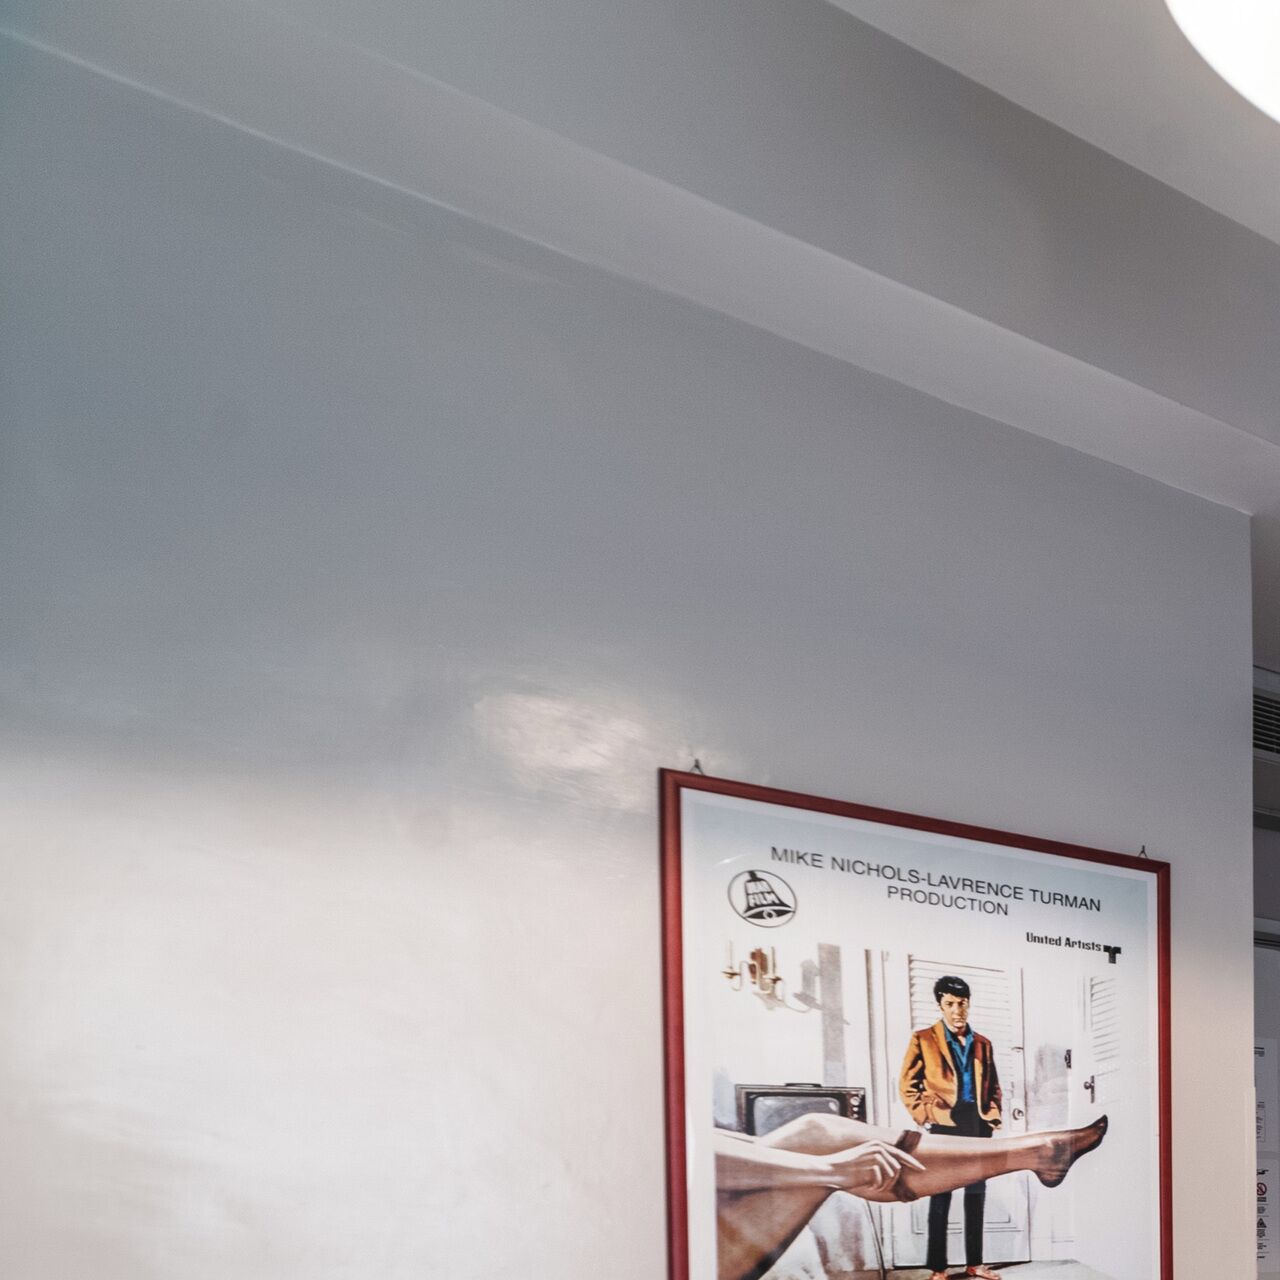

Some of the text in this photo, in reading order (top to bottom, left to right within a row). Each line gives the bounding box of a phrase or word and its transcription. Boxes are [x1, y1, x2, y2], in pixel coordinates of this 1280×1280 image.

[770, 846, 1101, 913] MIKE NICHOLS-LAVRENCE TURMAN
[887, 885, 1009, 916] PRODUCTION
[1026, 931, 1102, 952] United Artists
